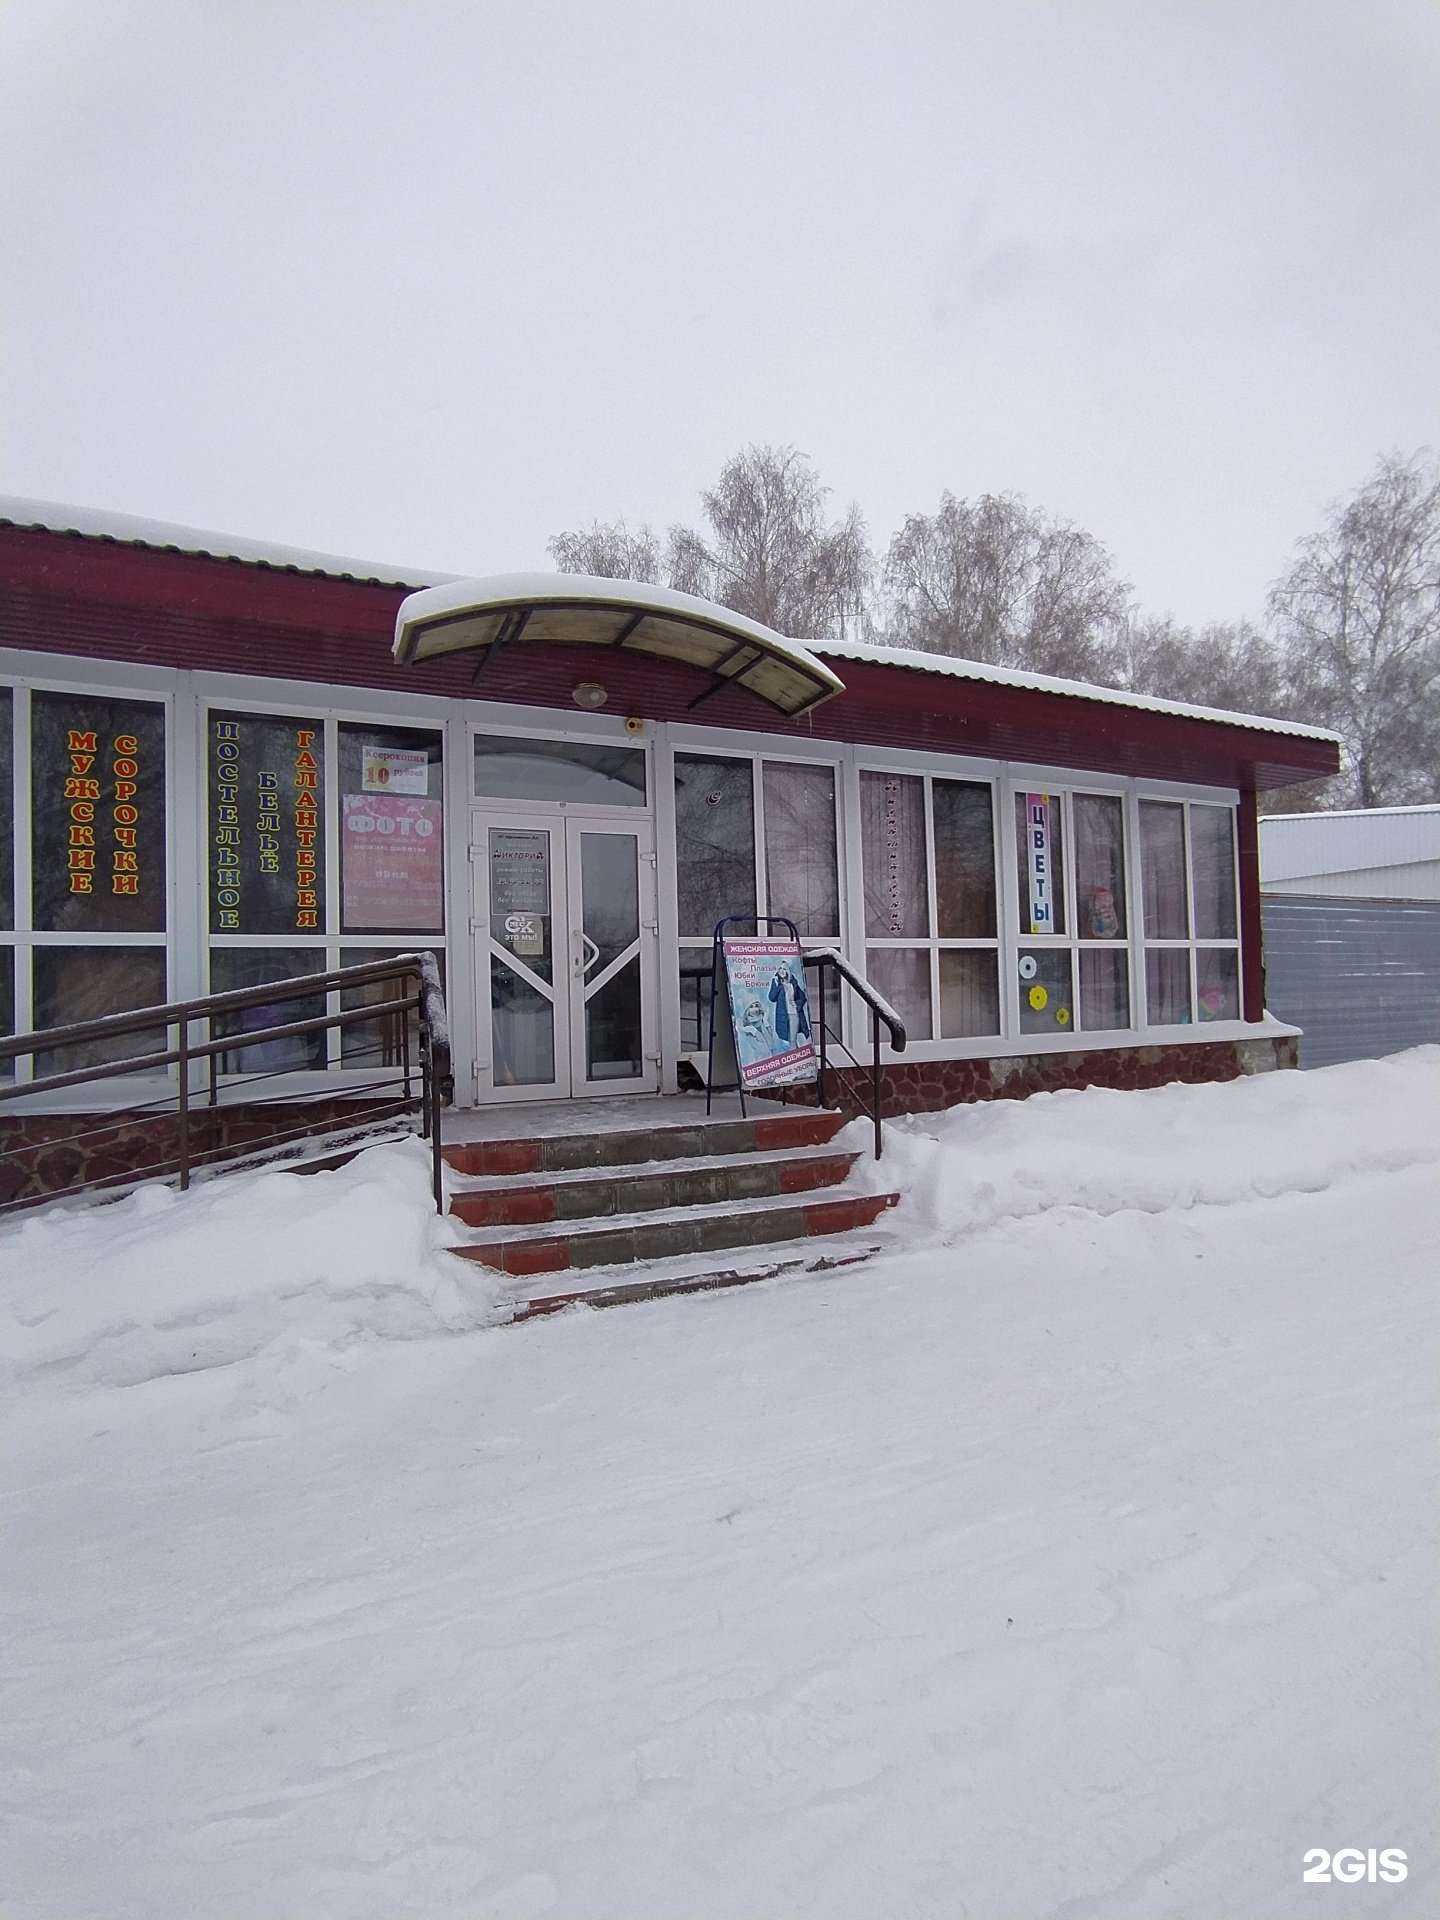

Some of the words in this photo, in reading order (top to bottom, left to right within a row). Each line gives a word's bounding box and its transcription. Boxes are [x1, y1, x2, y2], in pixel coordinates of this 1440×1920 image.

[65, 730, 100, 894] МУЖСКИЕ
[112, 735, 138, 894] СОРОЧКИ
[216, 720, 240, 928] ПОСТЕЛЬНОЕ
[256, 771, 280, 873] БЕЛЬЁ
[294, 730, 318, 928] ГАЛАНТЕРЕЯ
[347, 815, 434, 837] ФОТО
[367, 767, 390, 785] 10
[1033, 806, 1050, 921] ЦВЕТЫ
[730, 945, 767, 953] ЖЕНСКАЯ
[768, 945, 798, 953] ОДЕЖДА
[746, 1059, 780, 1077] ВЕРХНЯЯ
[781, 1048, 811, 1064] ОДЕЖДА
